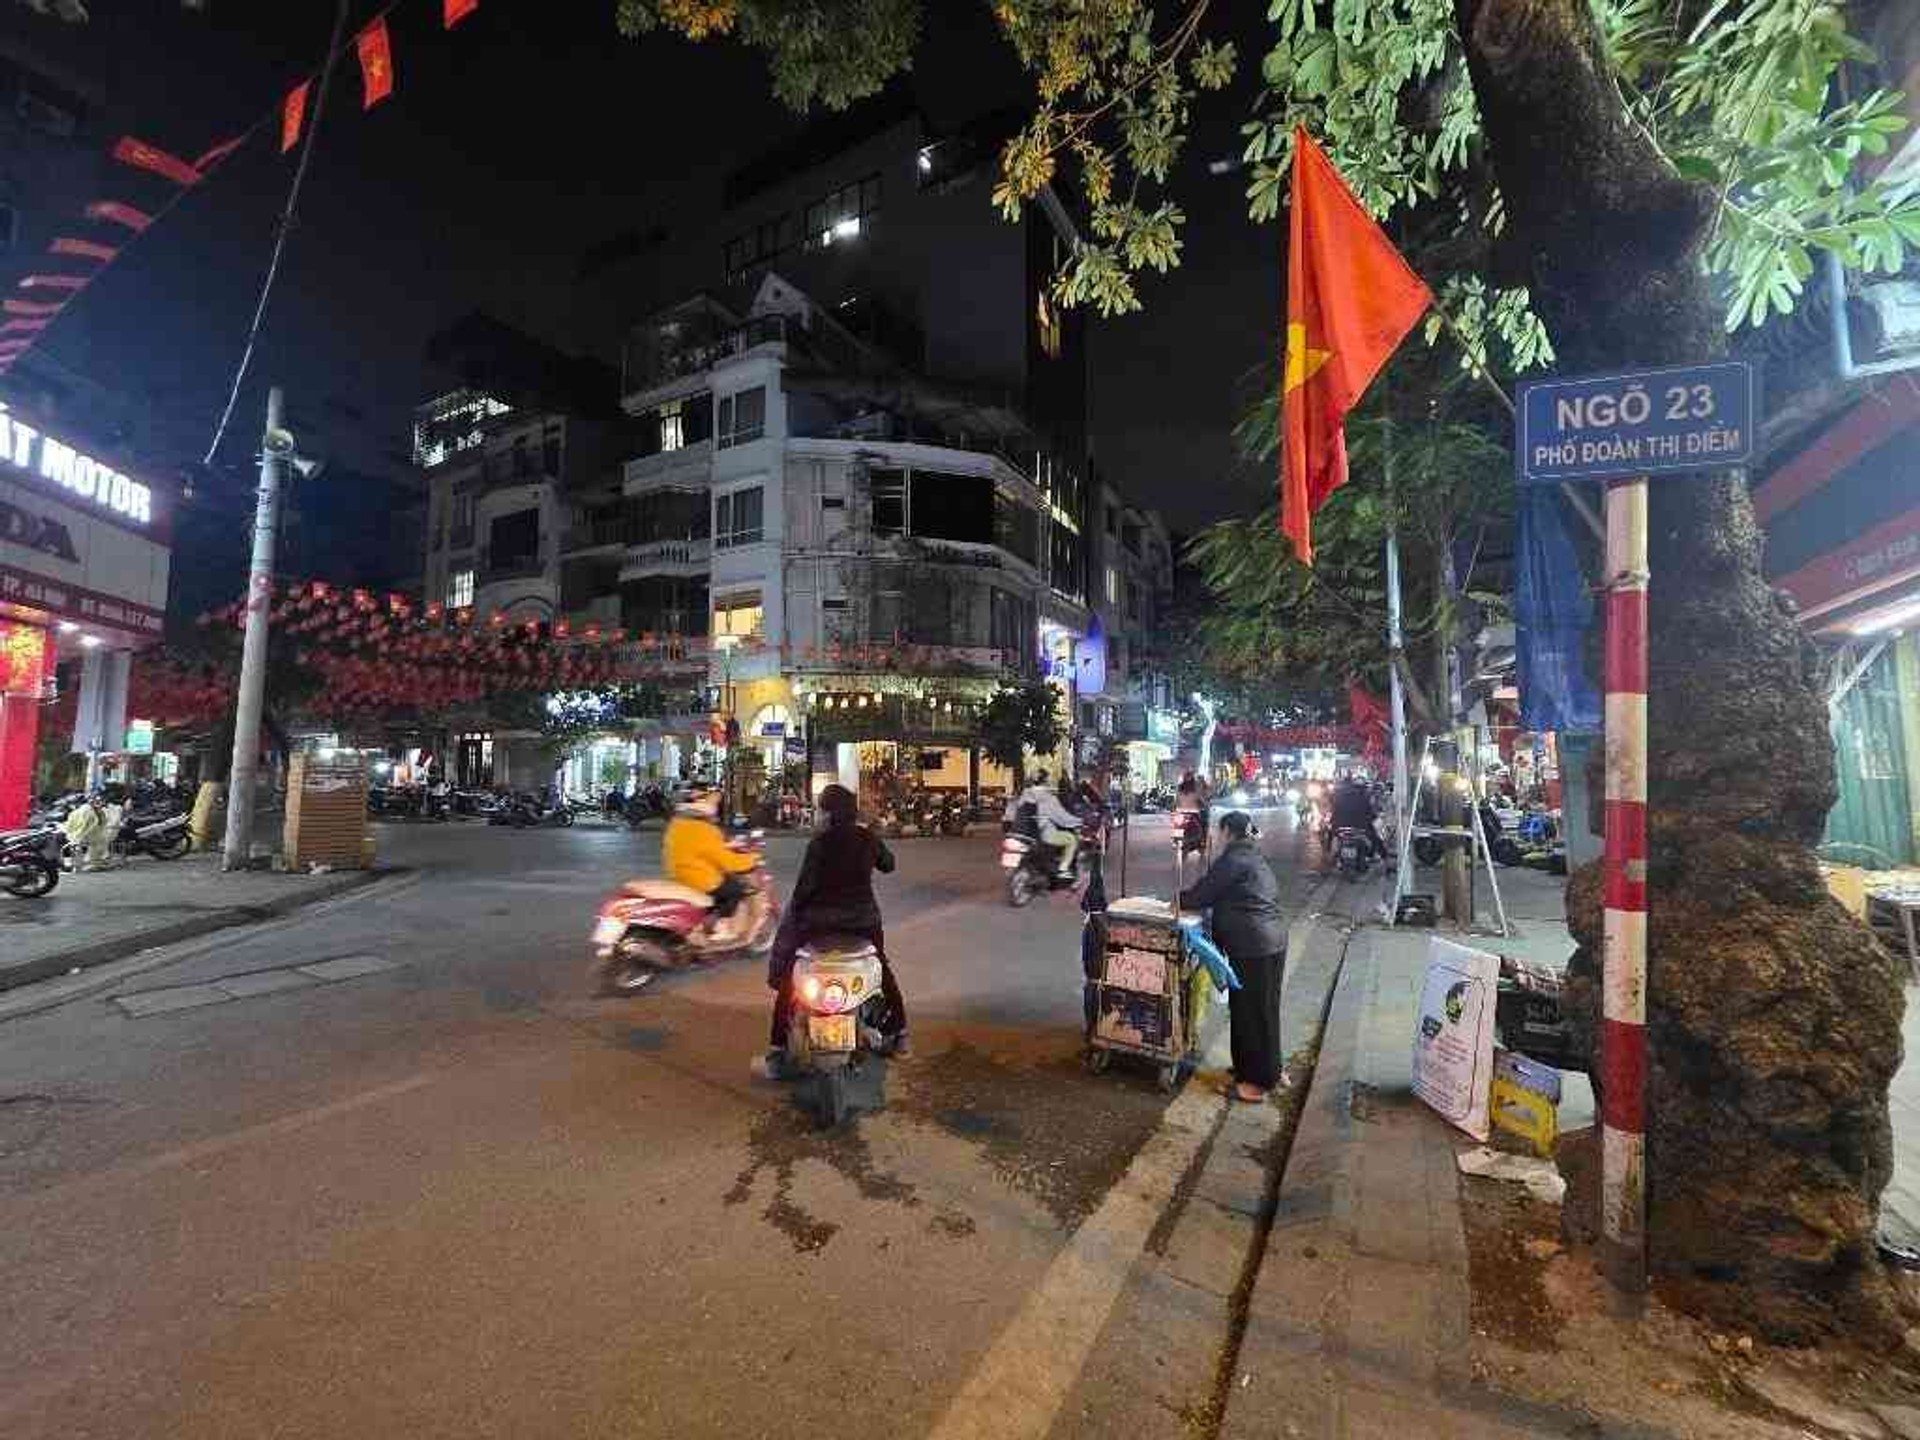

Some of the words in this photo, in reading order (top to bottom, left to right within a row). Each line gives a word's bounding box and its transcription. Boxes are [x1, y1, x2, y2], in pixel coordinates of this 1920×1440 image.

[1557, 384, 1650, 431] NGÕ
[1664, 384, 1715, 420] 23
[1535, 435, 1576, 467] PHỐ
[1581, 432, 1640, 464] ĐOÀN
[1646, 434, 1680, 460] THỊ
[41, 436, 151, 523] MOTOR
